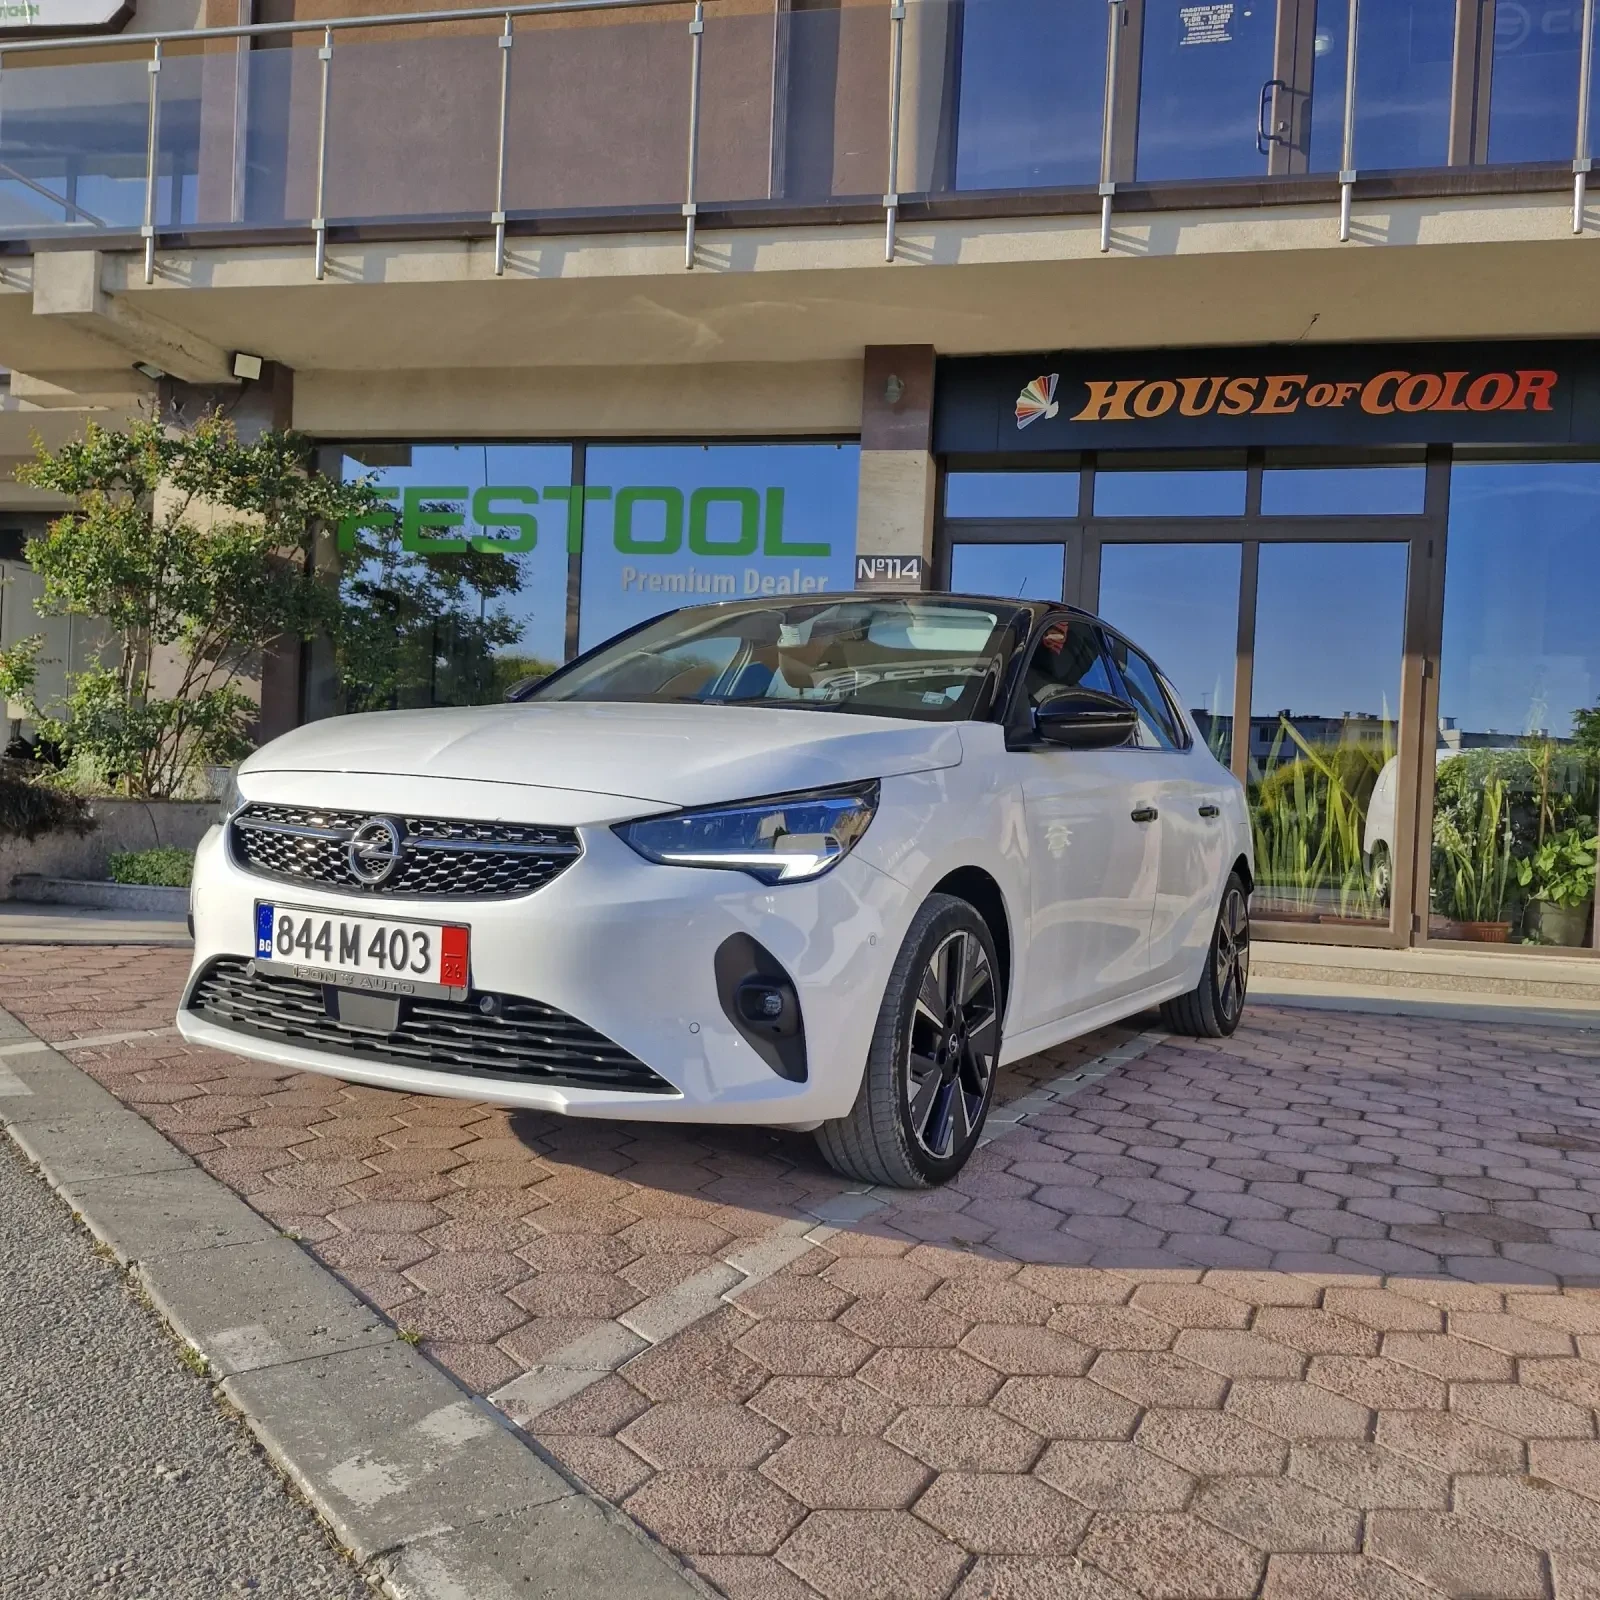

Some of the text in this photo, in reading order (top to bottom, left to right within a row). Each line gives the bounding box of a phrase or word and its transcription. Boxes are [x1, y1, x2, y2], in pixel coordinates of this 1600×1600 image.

[1069, 370, 1558, 421] HOUSE OF COLOR
[337, 485, 832, 557] FESTOOL
[622, 565, 829, 595] Premium Dealer
[259, 938, 272, 952] BG
[276, 915, 431, 975] 844 M 403
[359, 976, 415, 994] AUTO
